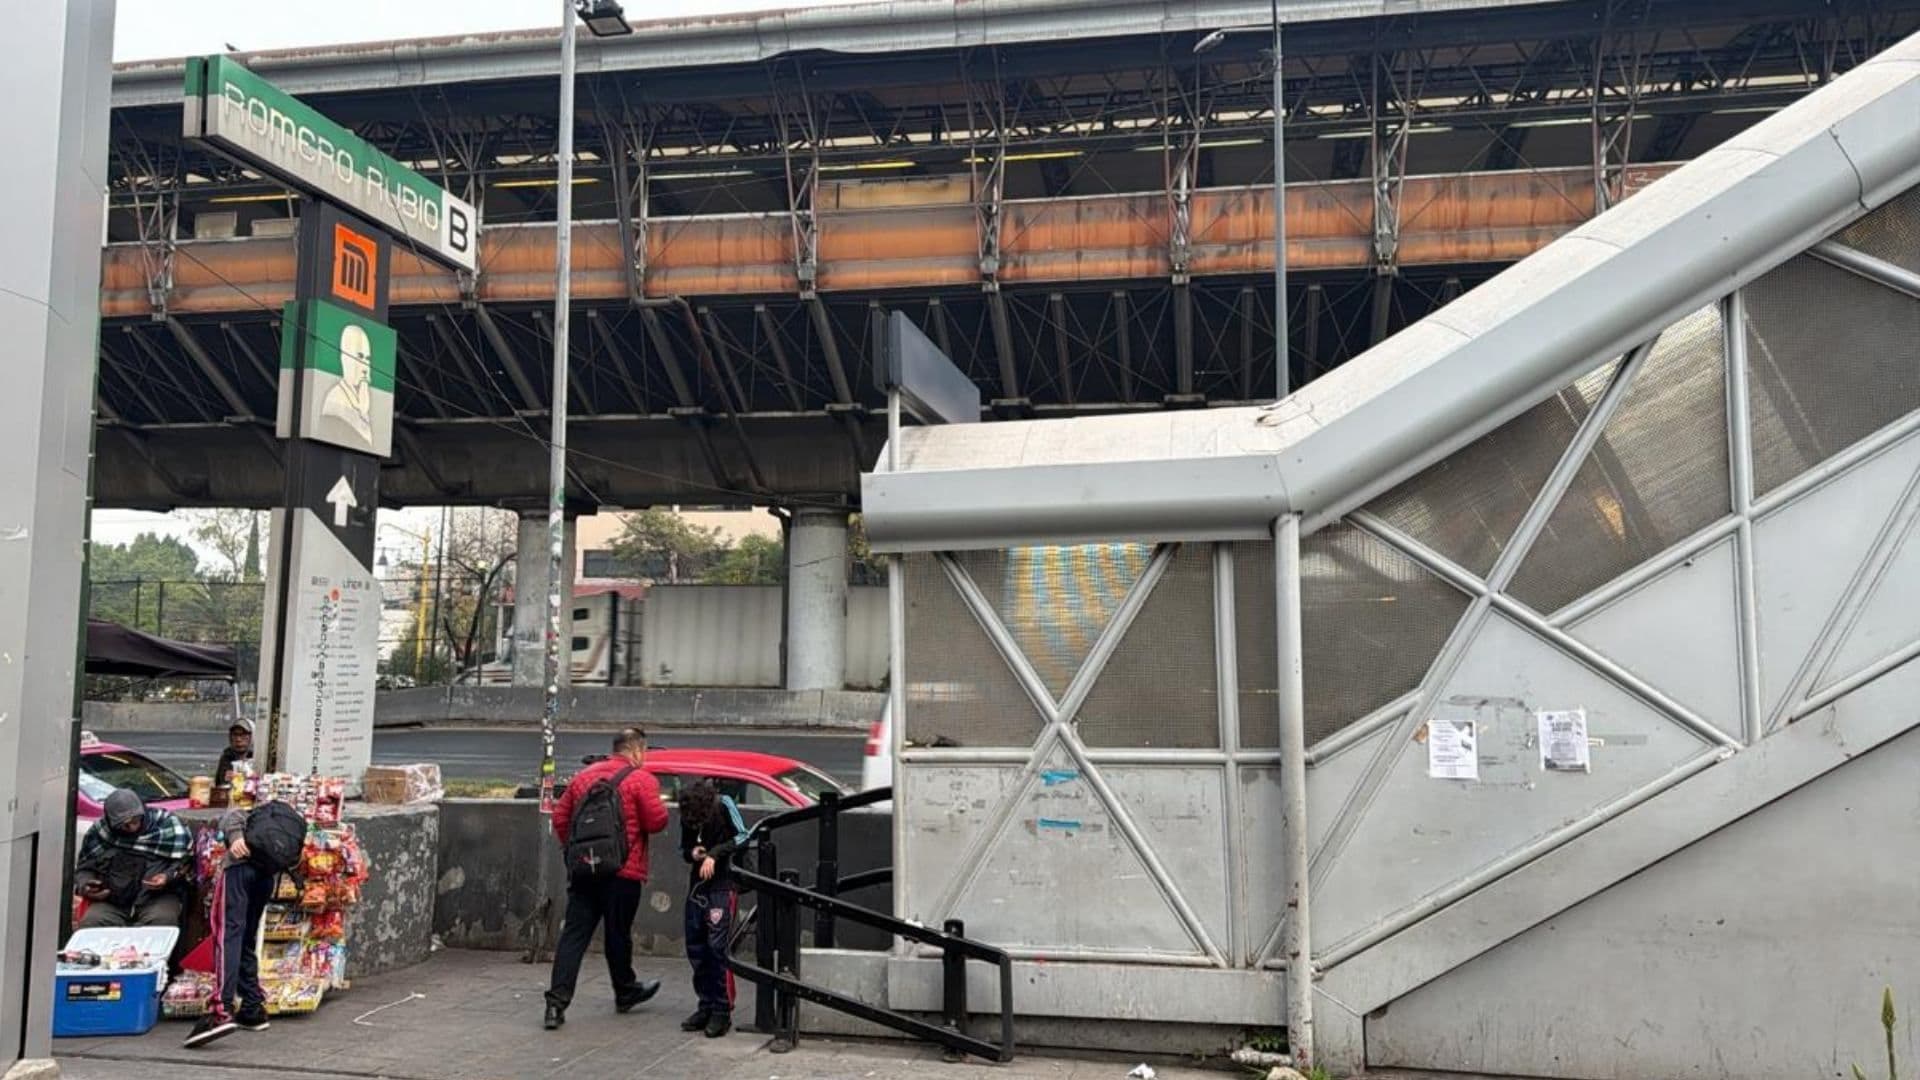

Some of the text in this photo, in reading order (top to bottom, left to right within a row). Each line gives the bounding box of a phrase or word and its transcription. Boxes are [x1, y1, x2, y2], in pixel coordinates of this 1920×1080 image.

[223, 82, 469, 254] ROMERO RUBIO B
